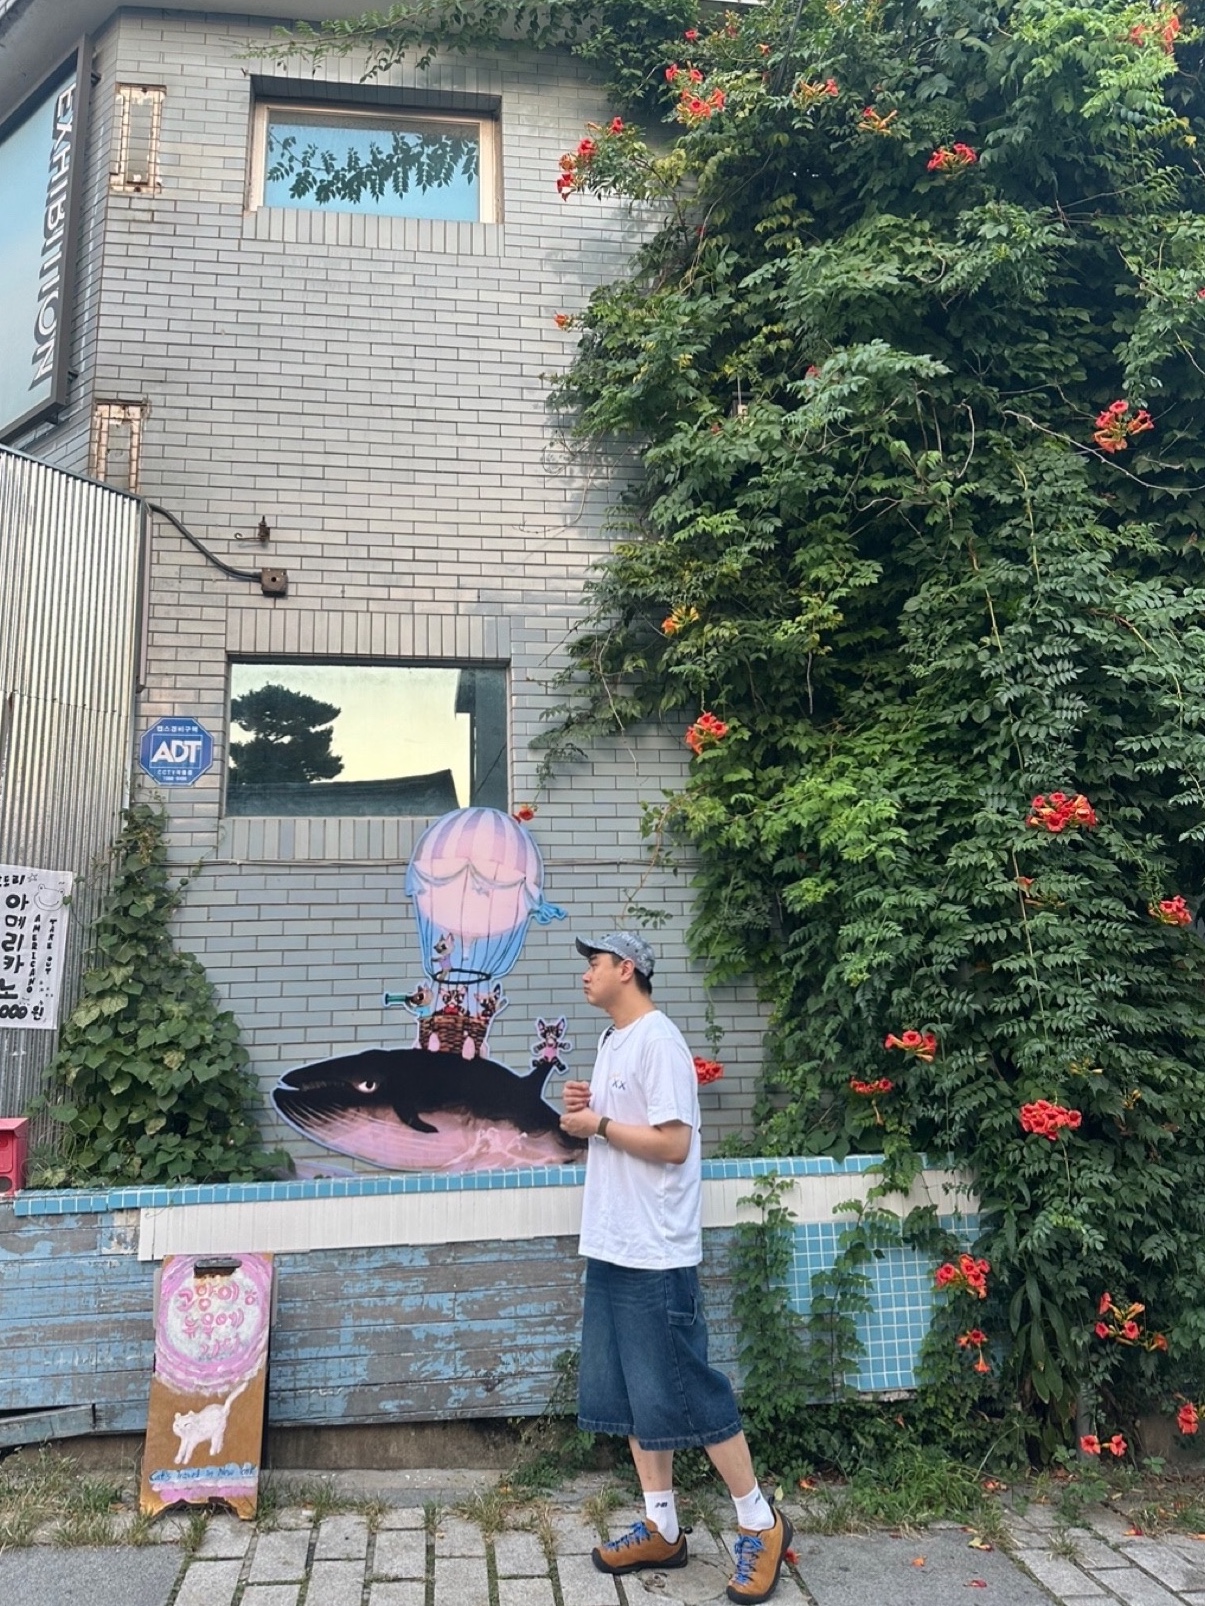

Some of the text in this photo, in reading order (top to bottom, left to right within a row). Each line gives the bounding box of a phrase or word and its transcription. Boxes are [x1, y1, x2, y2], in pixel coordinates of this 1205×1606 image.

[150, 740, 202, 763] ADT
[0, 894, 29, 999] 아메리카노
[26, 914, 41, 993] AMERICANO
[47, 919, 57, 949] TAKE
